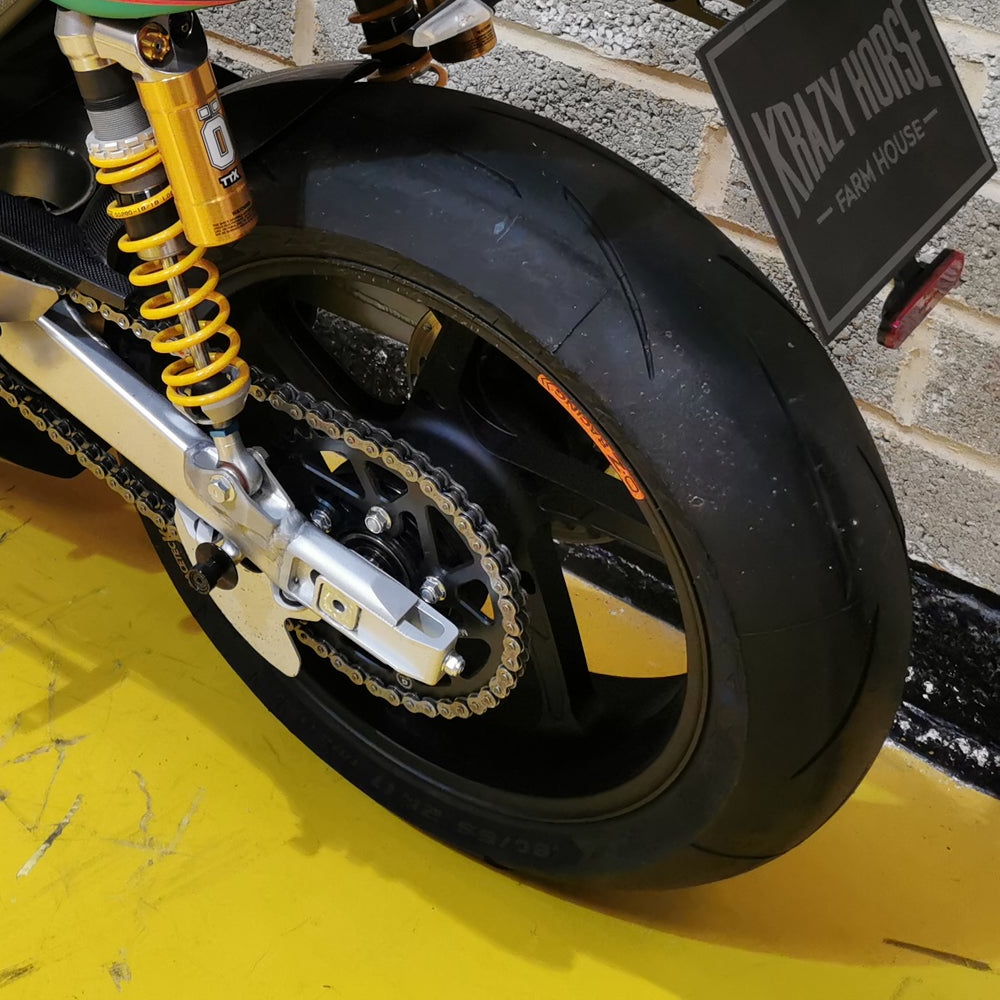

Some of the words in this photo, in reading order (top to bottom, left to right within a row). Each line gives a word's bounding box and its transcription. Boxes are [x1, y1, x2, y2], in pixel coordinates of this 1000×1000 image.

[220, 170, 241, 187] TTX
[750, 66, 856, 219] KRAZY
[835, 159, 878, 213] FARM
[872, 118, 926, 175] HOUSE
